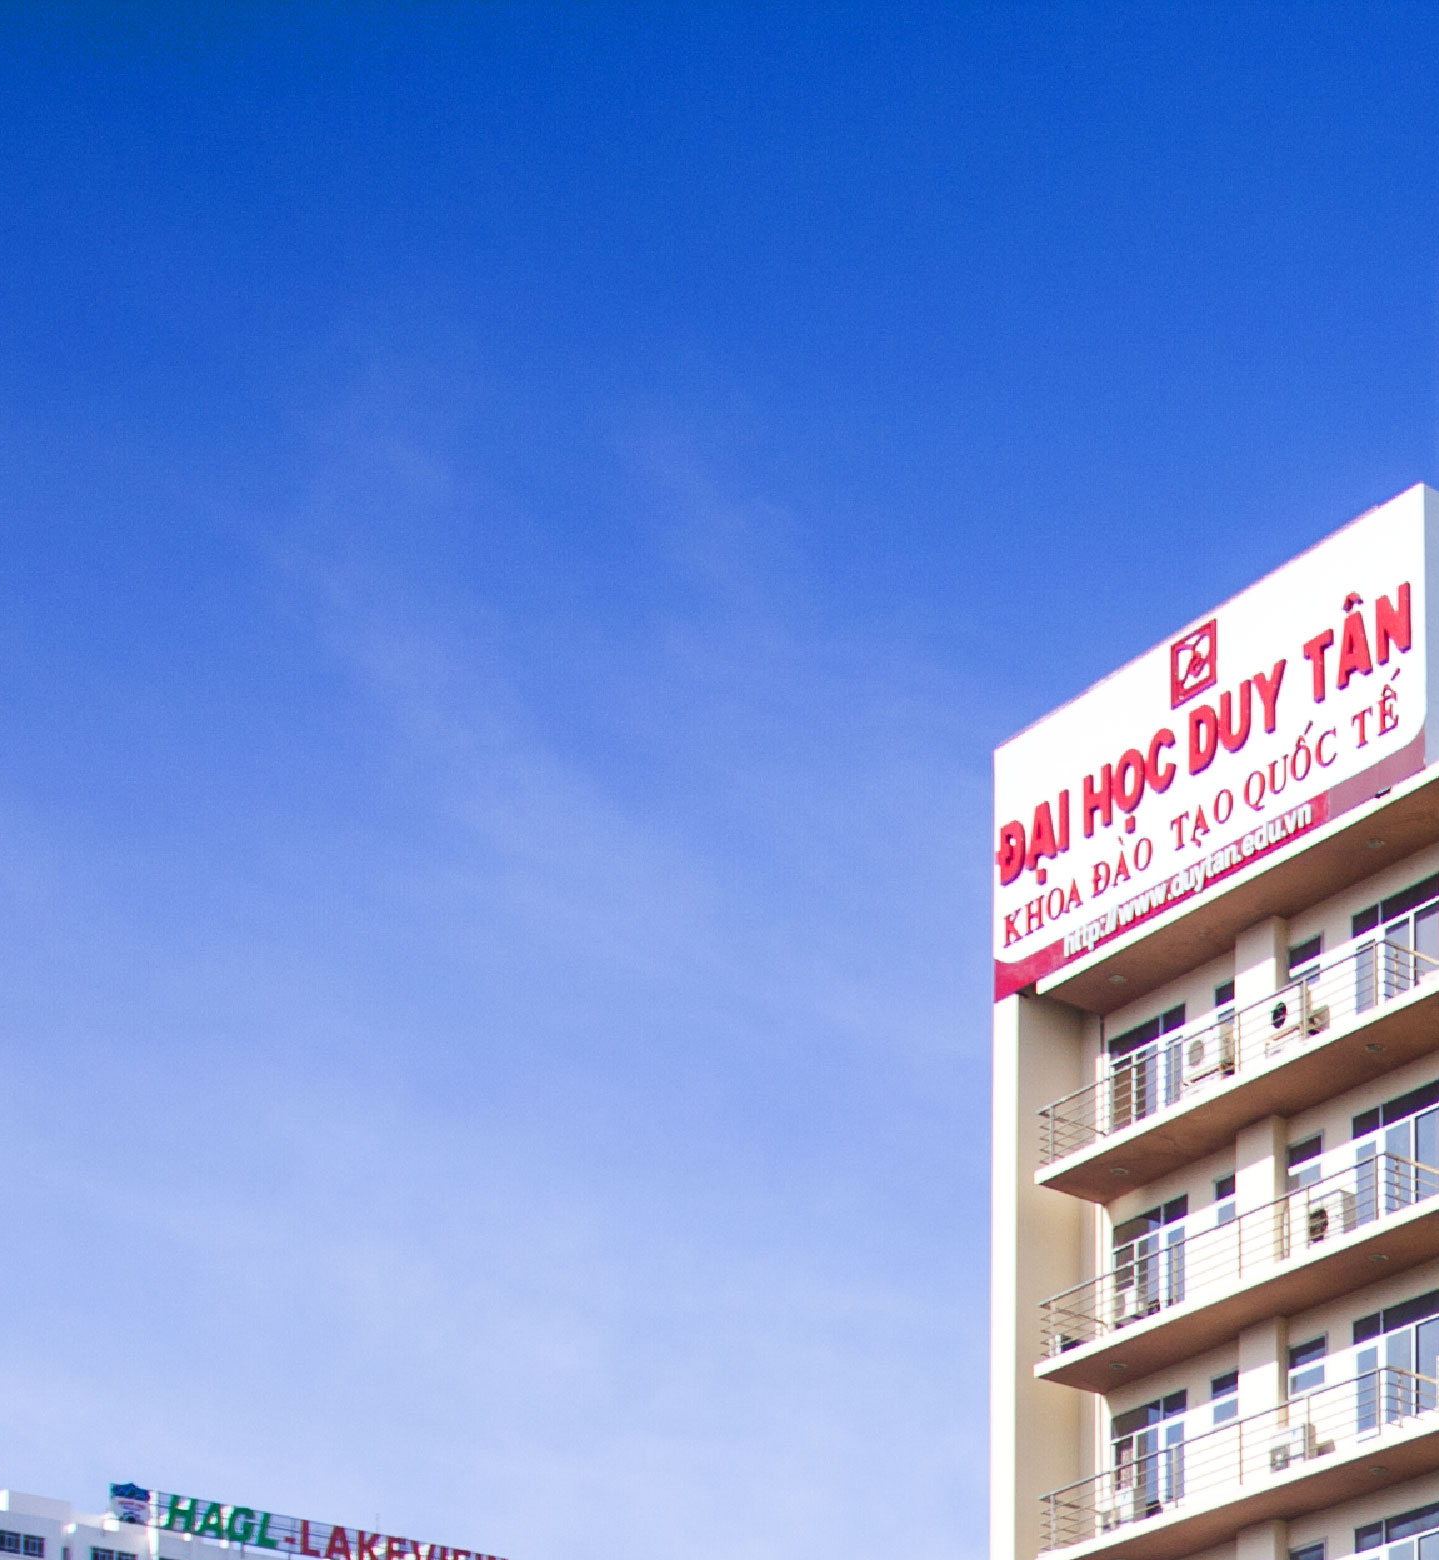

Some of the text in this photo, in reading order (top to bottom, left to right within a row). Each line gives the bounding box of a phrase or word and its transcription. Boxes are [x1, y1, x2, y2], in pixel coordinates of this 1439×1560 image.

[996, 581, 1411, 886] ĐẠI HỌC DUY TÂN
[1002, 668, 1401, 948] KHOA ĐÀO TẠO QUỐC TẾ
[1063, 801, 1313, 958] http://www.duytan.edu.vn
[165, 1494, 278, 1549] HAGL
